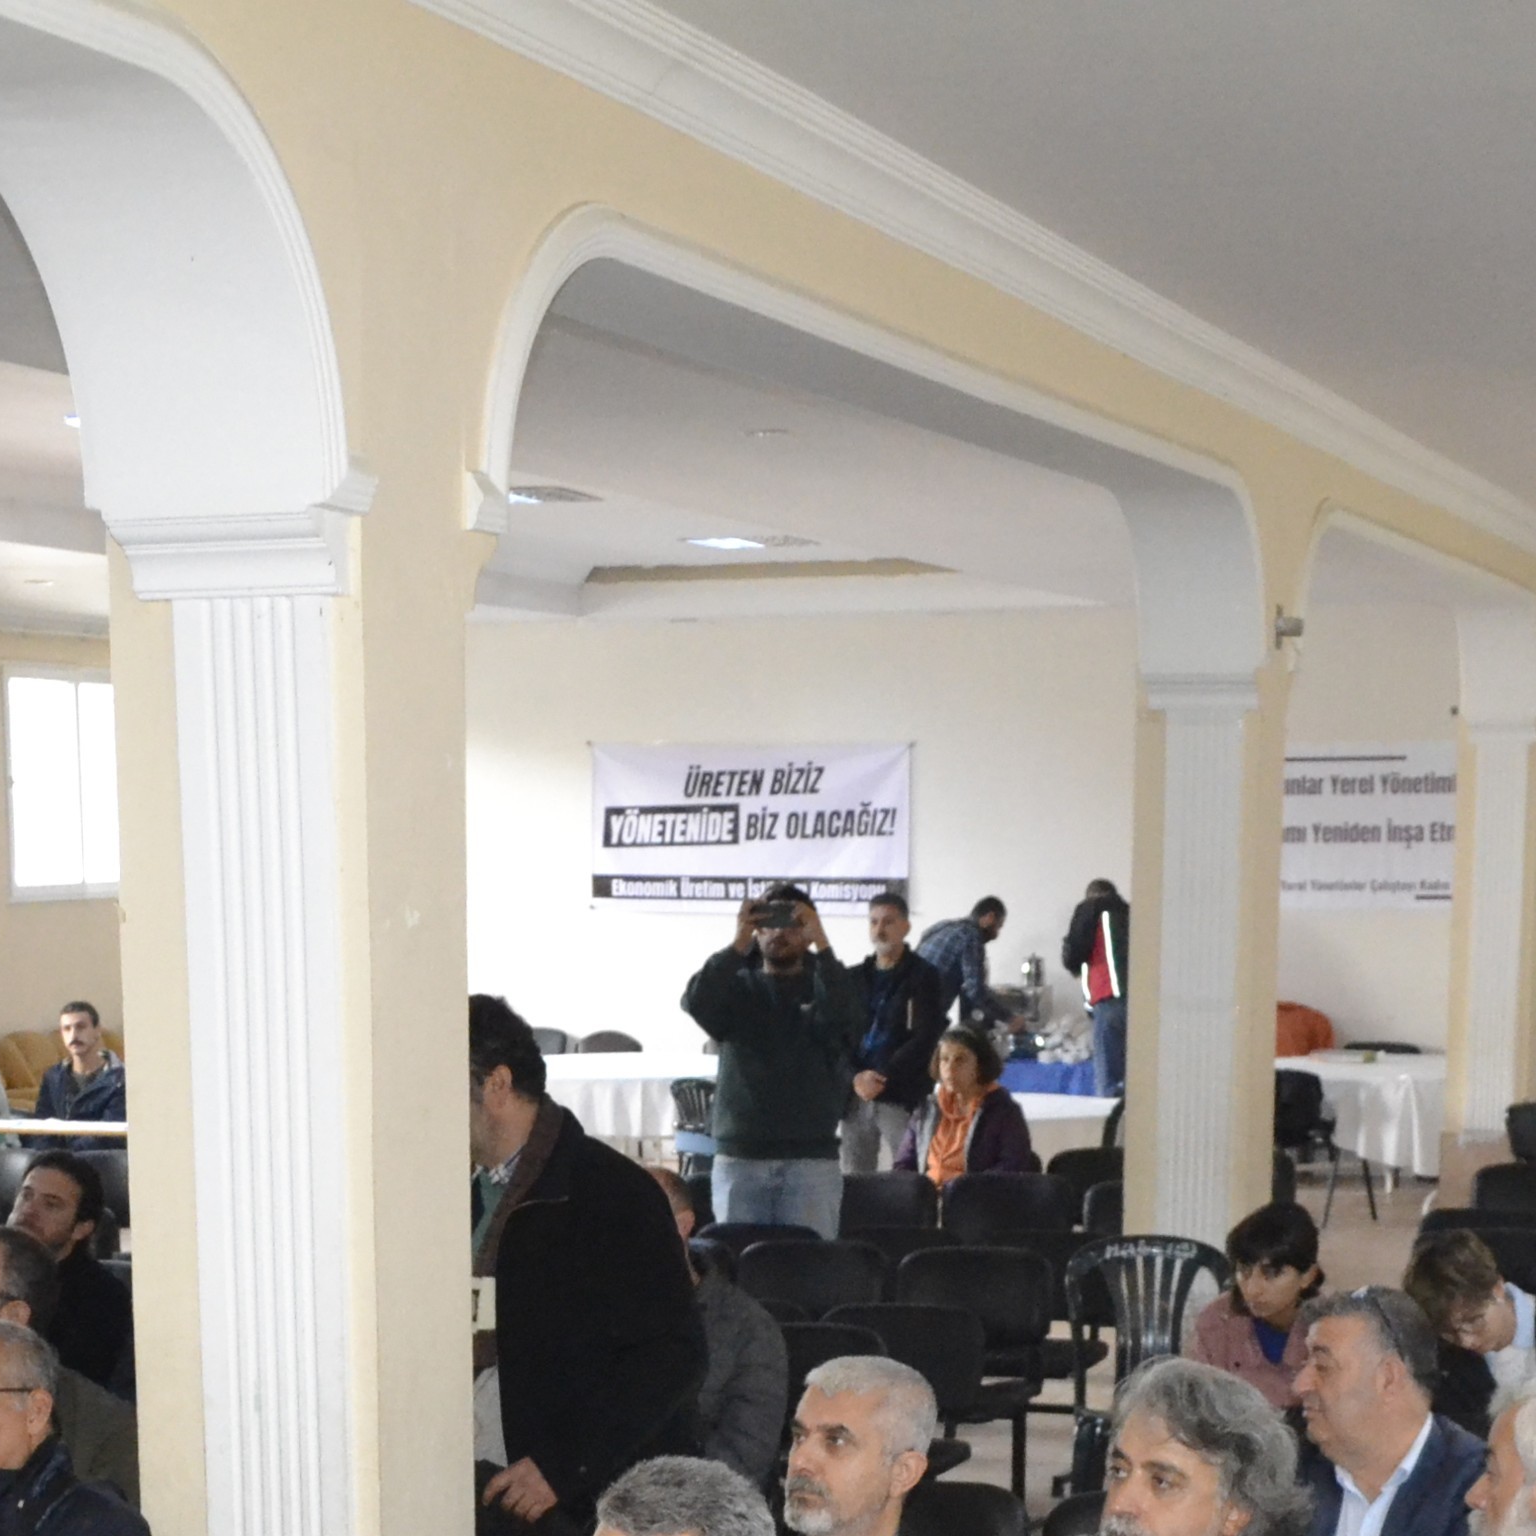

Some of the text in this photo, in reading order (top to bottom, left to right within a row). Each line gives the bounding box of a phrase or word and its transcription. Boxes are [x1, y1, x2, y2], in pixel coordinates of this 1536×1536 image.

[683, 761, 825, 798] ÜRETEN BİZİZ
[1331, 774, 1375, 795] Yerel
[609, 801, 897, 845] YÖNETENİDE BİZ OLACAĞIZ!
[1312, 821, 1382, 843] Yeniden
[1387, 818, 1425, 849] İnşa
[611, 877, 678, 898] Ekonomik
[680, 876, 726, 899] Üretim
[728, 882, 746, 898] ve
